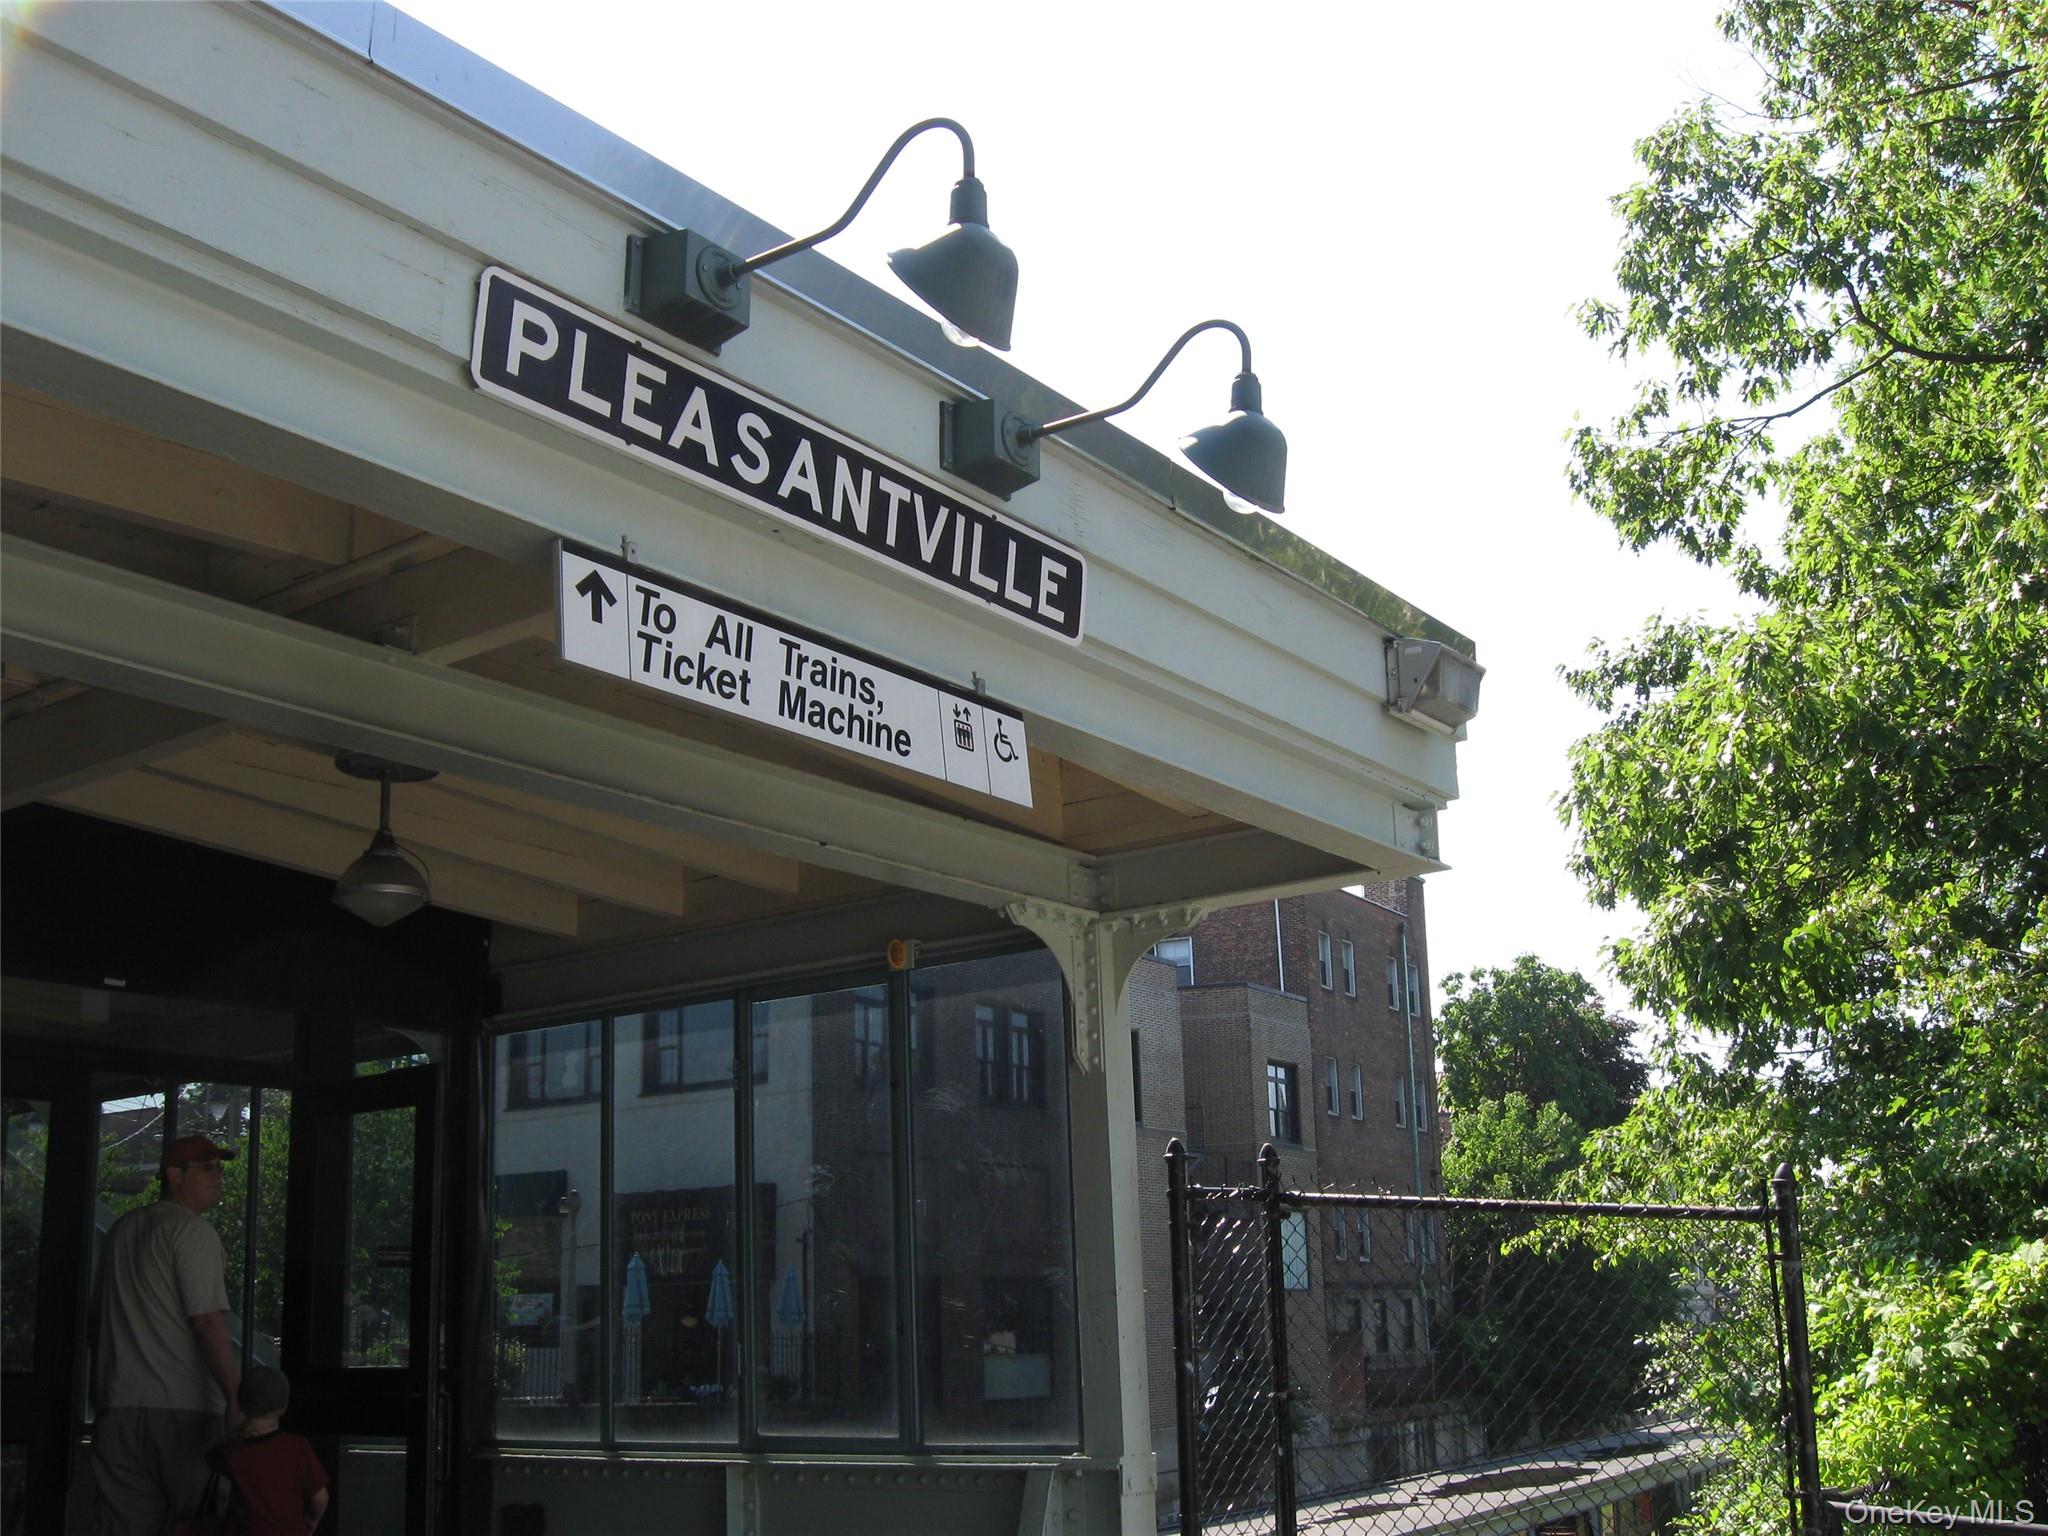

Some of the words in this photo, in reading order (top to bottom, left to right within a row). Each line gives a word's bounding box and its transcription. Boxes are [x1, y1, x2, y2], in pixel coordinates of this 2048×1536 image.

[506, 298, 1068, 624] PLEASANTVILLE
[635, 585, 677, 634] To
[705, 621, 754, 662] All
[779, 637, 884, 715] Trains,
[637, 631, 751, 705] Ticket
[778, 680, 912, 757] Machine
